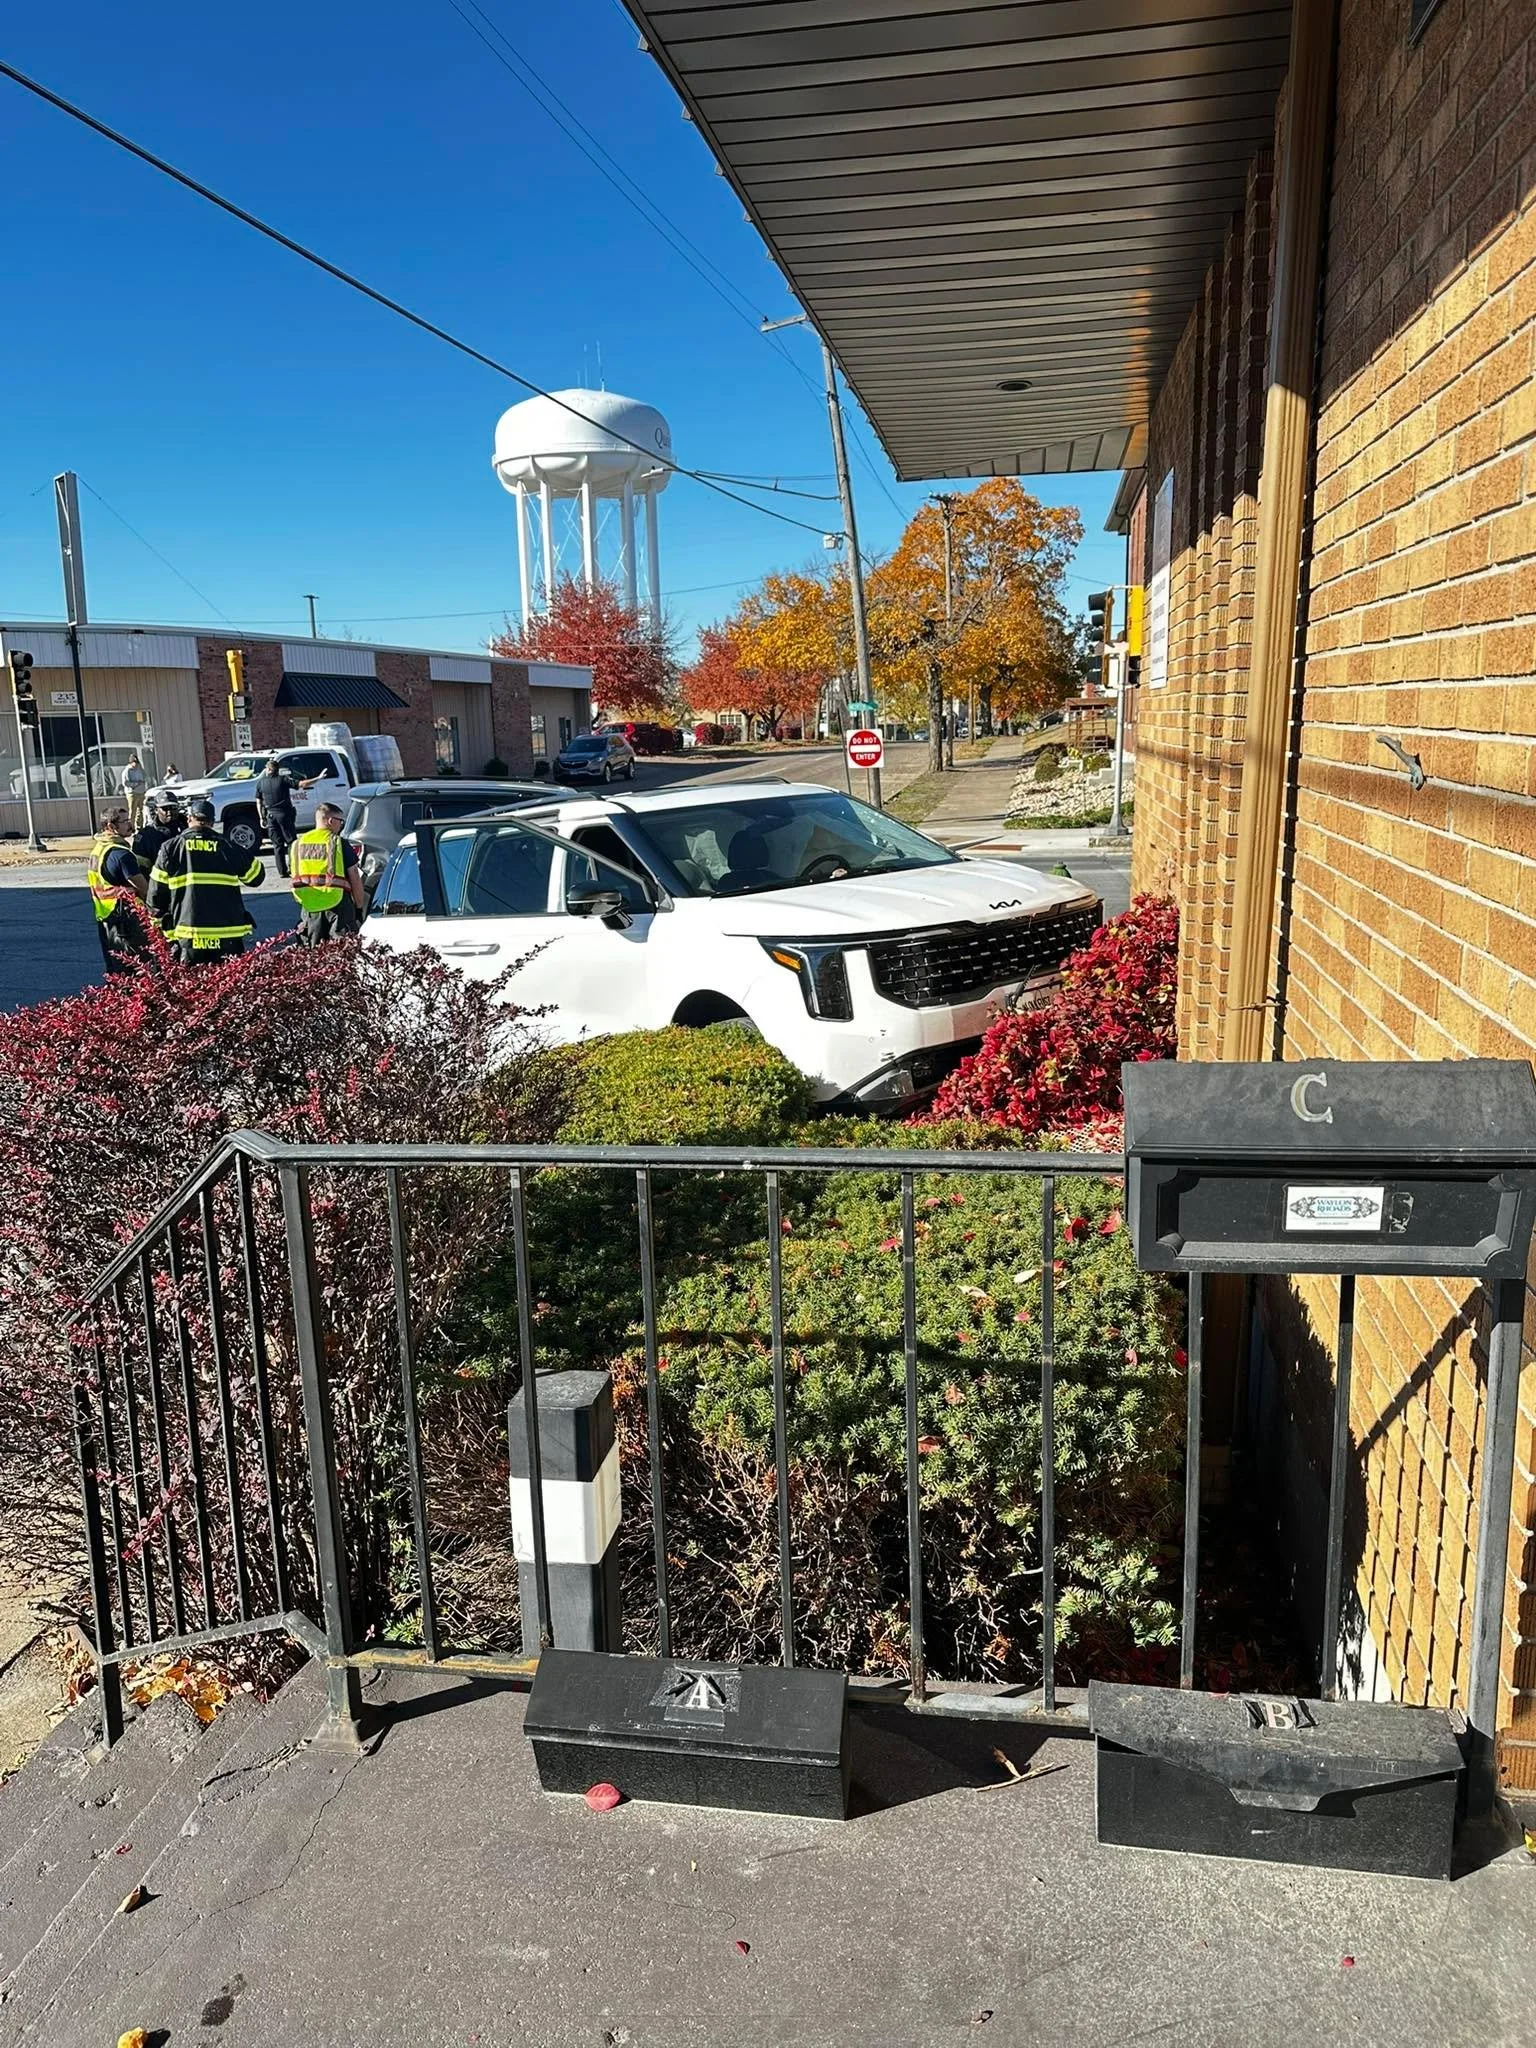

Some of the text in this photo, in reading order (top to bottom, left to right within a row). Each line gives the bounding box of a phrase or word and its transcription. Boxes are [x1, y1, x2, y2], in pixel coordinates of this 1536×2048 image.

[186, 839, 218, 852] QUINCY
[192, 937, 221, 949] BAKER
[1290, 1071, 1333, 1124] C
[684, 1672, 712, 1709] A
[1263, 1700, 1295, 1730] B
